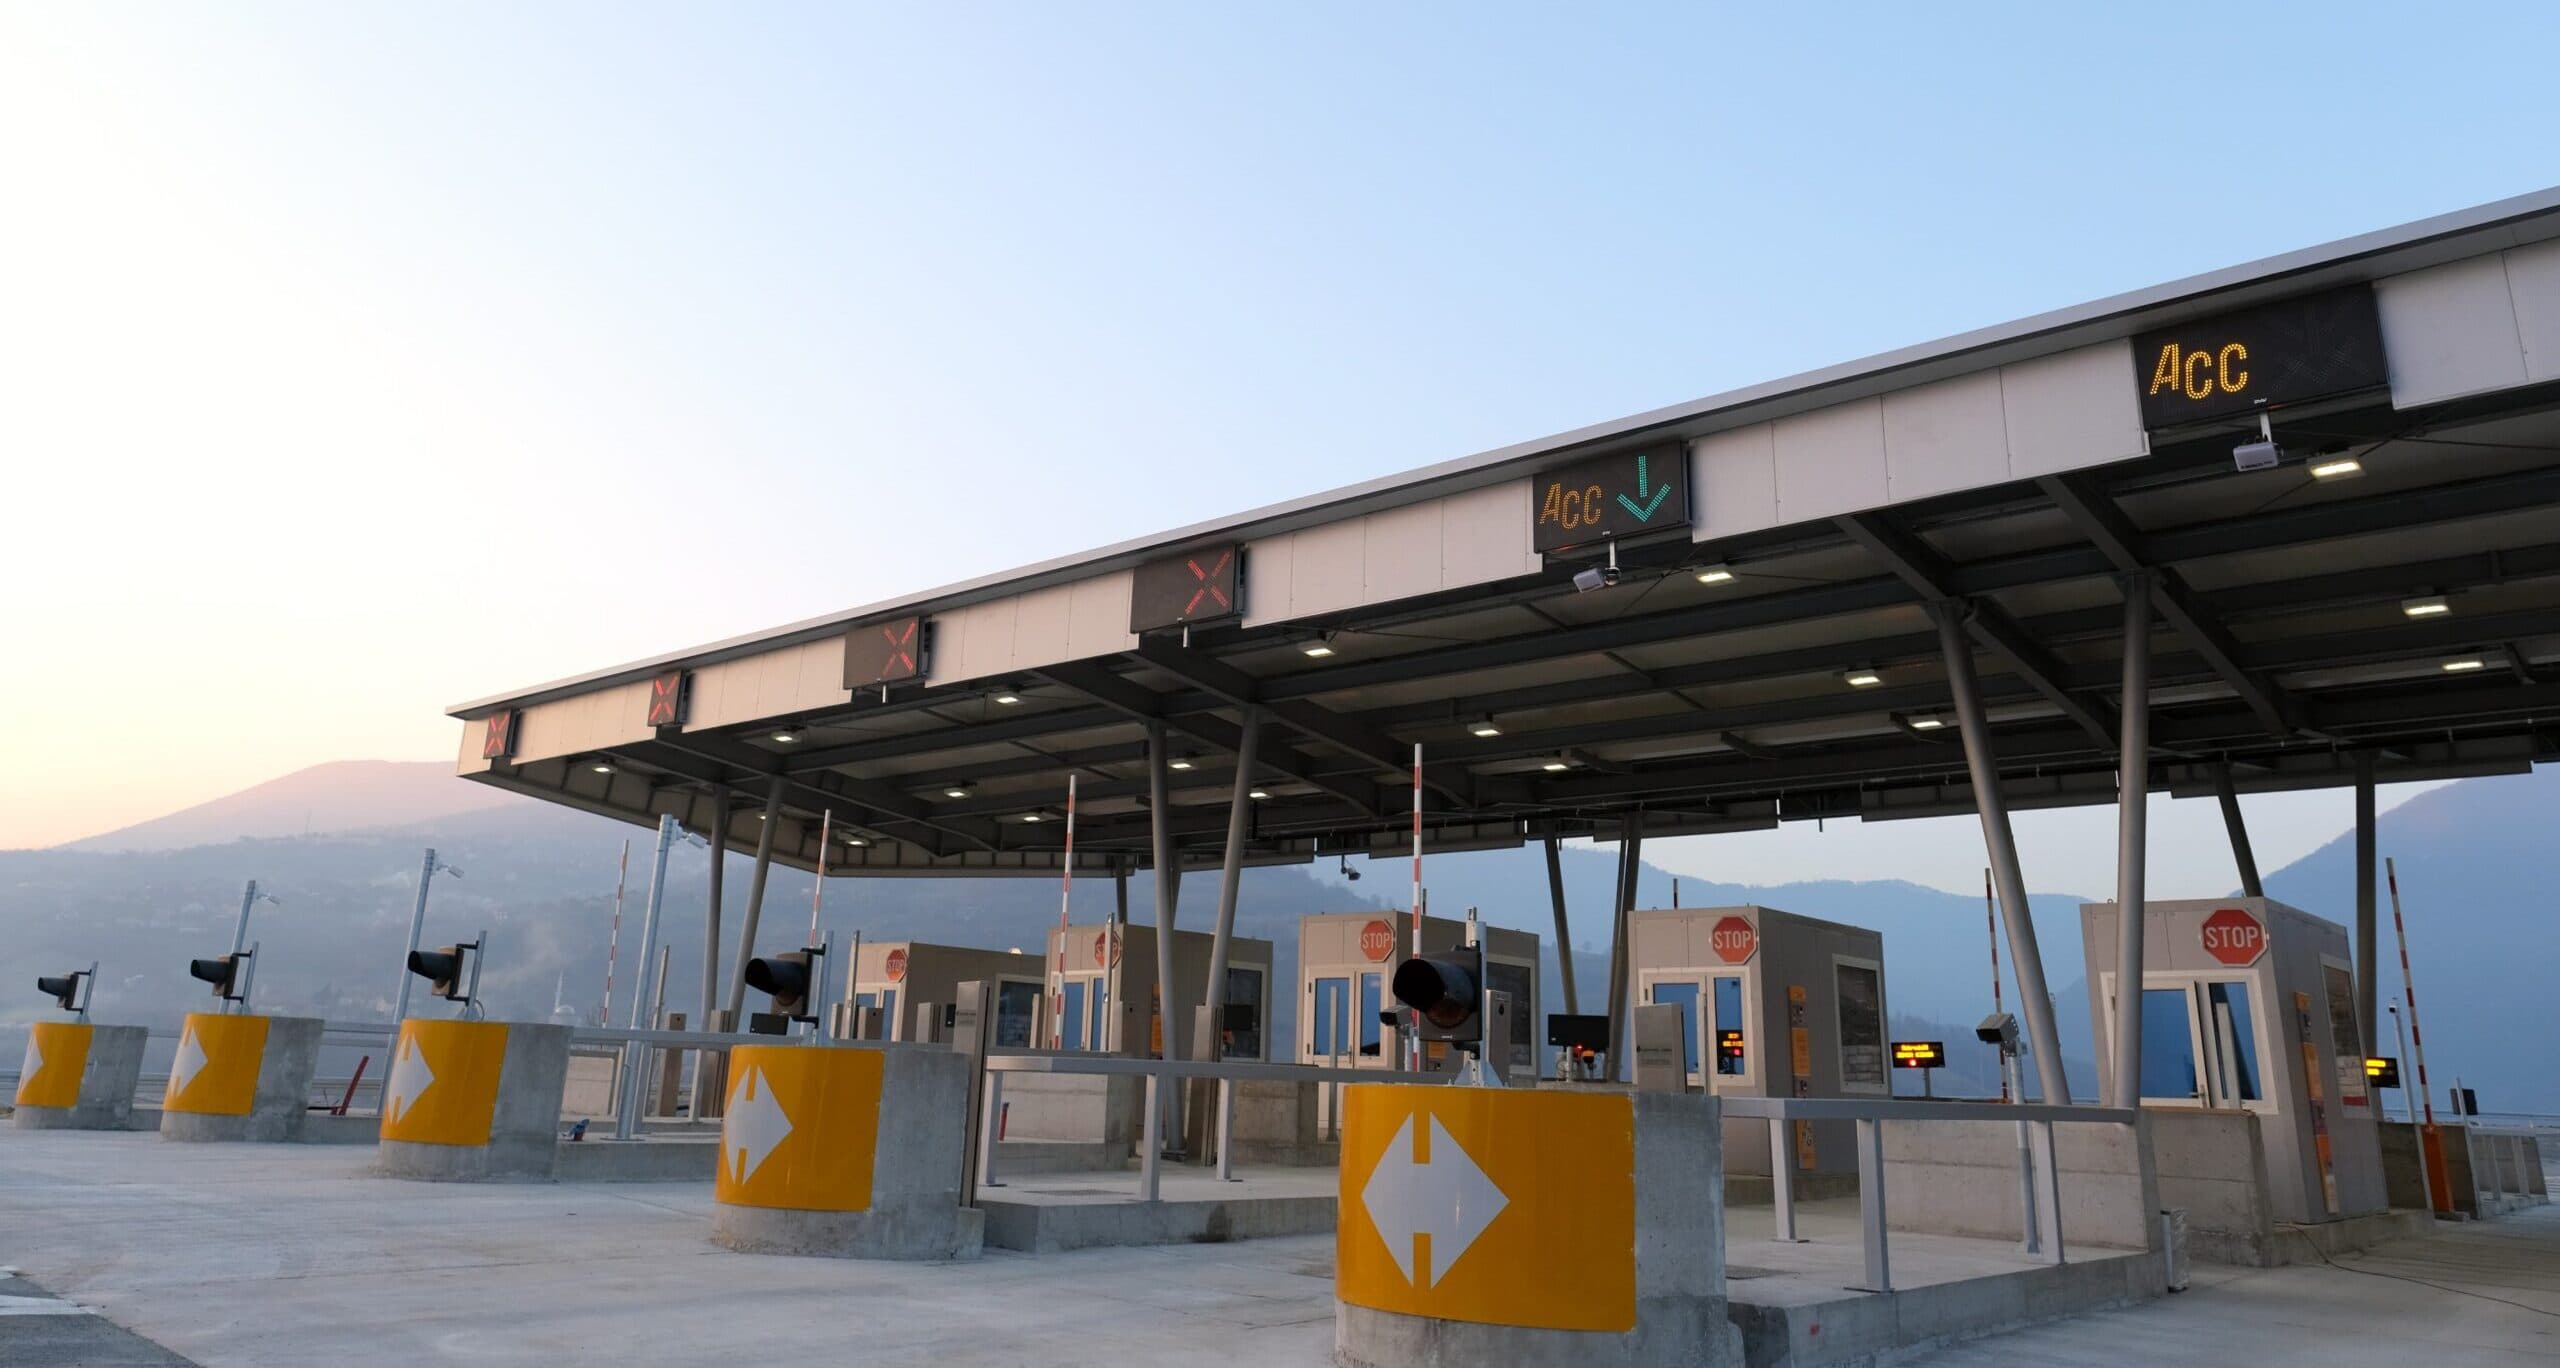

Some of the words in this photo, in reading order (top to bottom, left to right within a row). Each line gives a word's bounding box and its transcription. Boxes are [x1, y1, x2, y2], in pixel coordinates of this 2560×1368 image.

[2150, 344, 2248, 399] ACC
[1539, 483, 1602, 529] ACC
[1362, 932, 1390, 949] STOP
[1714, 930, 1751, 949] STOP
[2205, 926, 2258, 948] STOP
